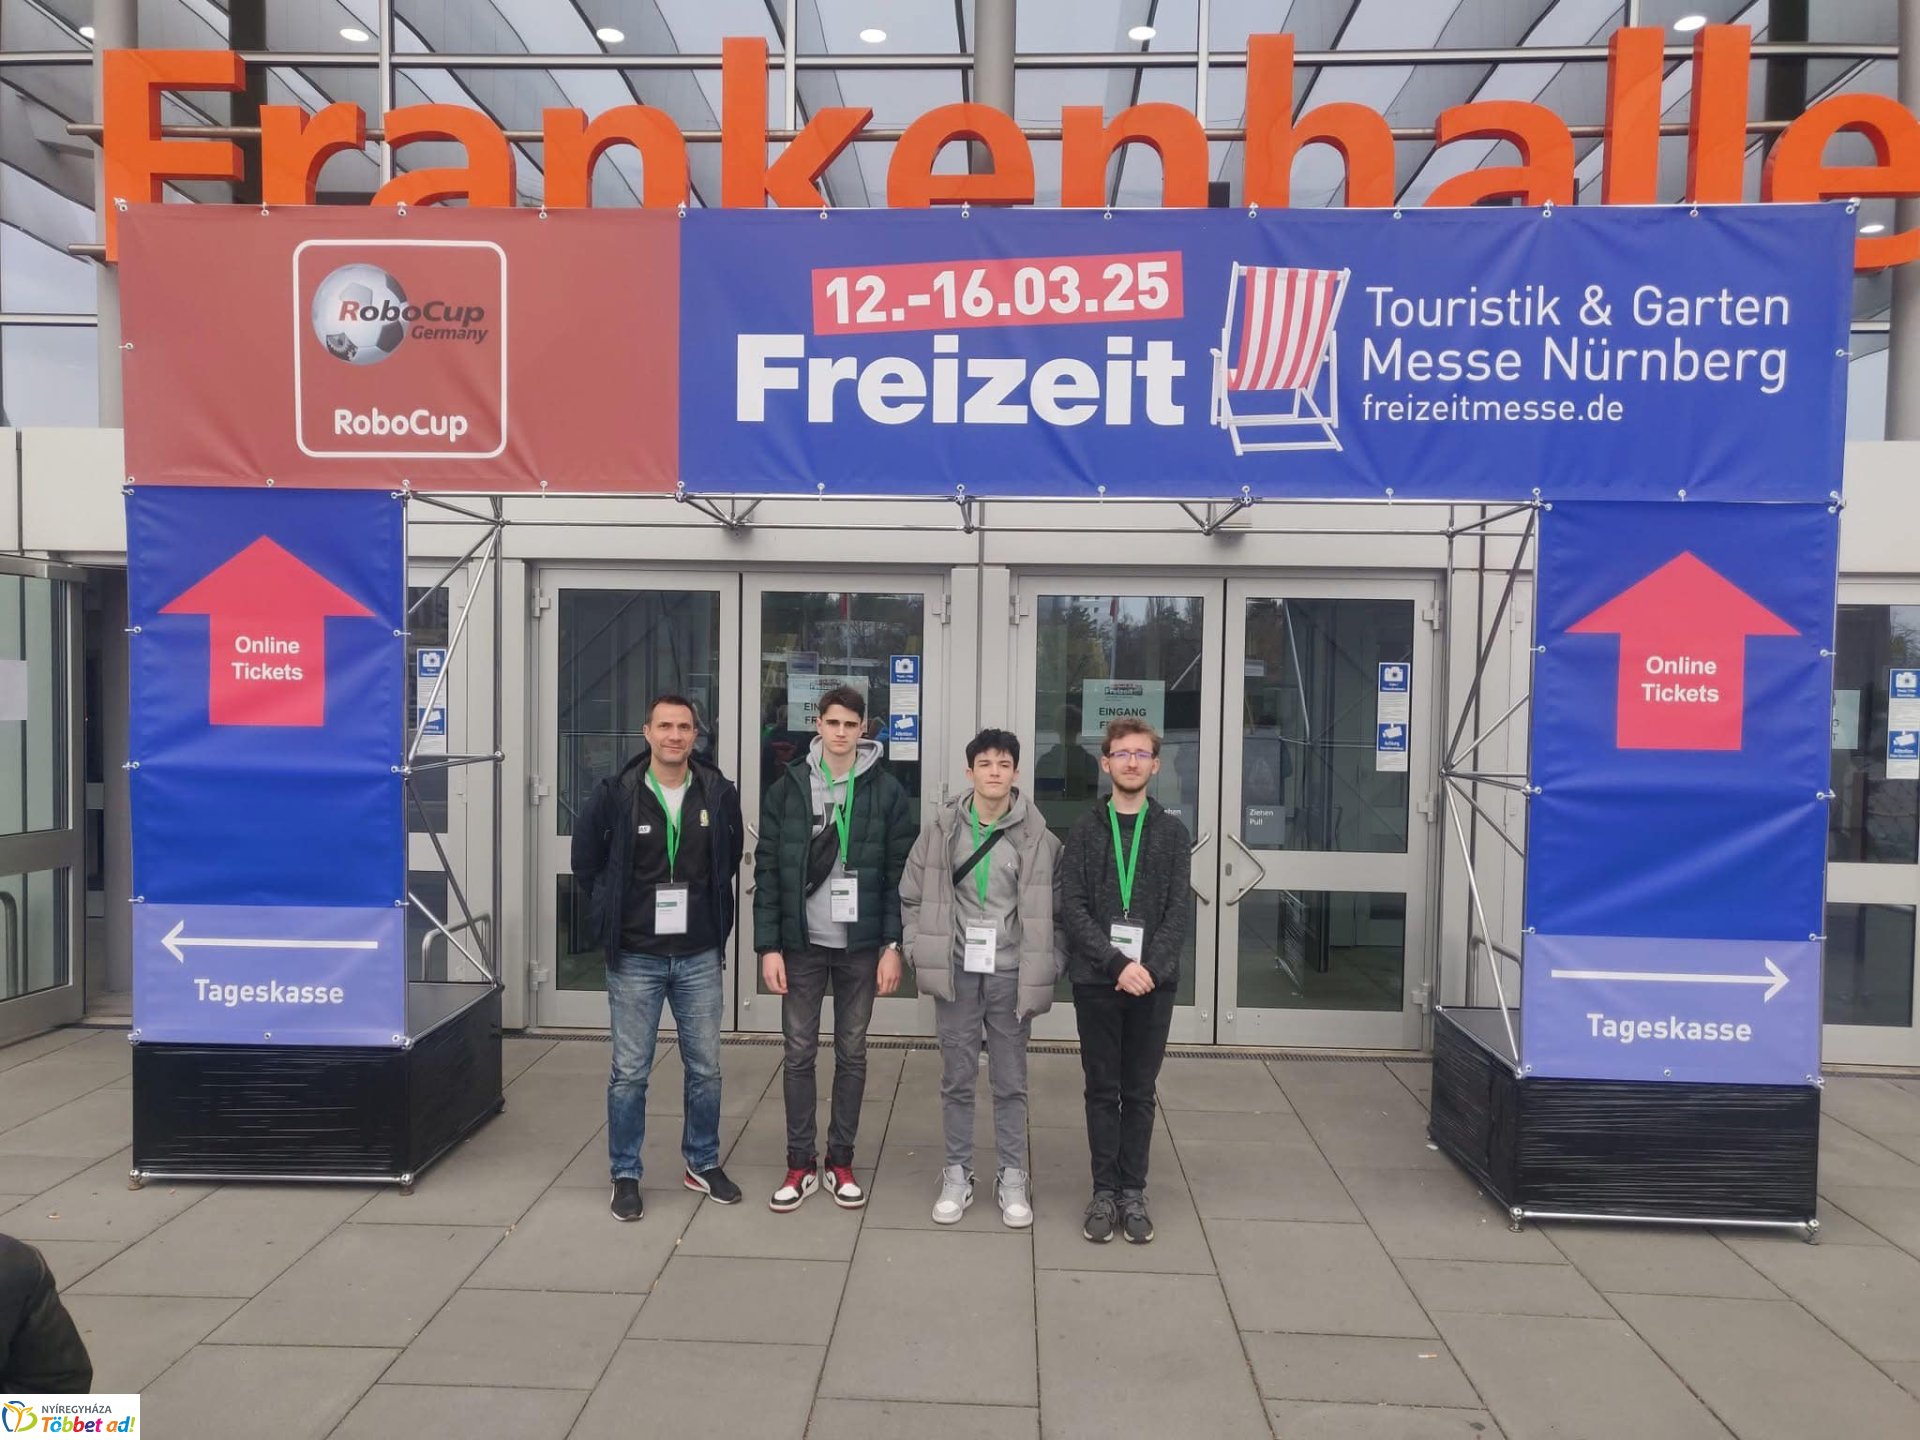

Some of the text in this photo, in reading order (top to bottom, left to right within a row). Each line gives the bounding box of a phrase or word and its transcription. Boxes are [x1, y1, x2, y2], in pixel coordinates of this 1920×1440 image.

[825, 261, 1169, 324] 12.-16.03.25
[1366, 285, 1789, 327] Touristik & Garten
[338, 300, 485, 328] RoboCup
[411, 325, 488, 344] Germany
[1362, 336, 1788, 394] Messe Nürnberg
[737, 334, 1186, 426] Freizeit
[1362, 393, 1624, 422] freizeitmesse.de
[334, 407, 469, 443] RoboCup
[234, 636, 300, 655] Online
[231, 662, 304, 681] Tickets
[1645, 656, 1717, 676] Online
[1641, 683, 1720, 704] Tickets
[1099, 707, 1147, 717] EINGANG
[1249, 817, 1263, 826] Pull
[194, 979, 344, 1007] Tageskasse
[1586, 1013, 1752, 1042] Tageskasse
